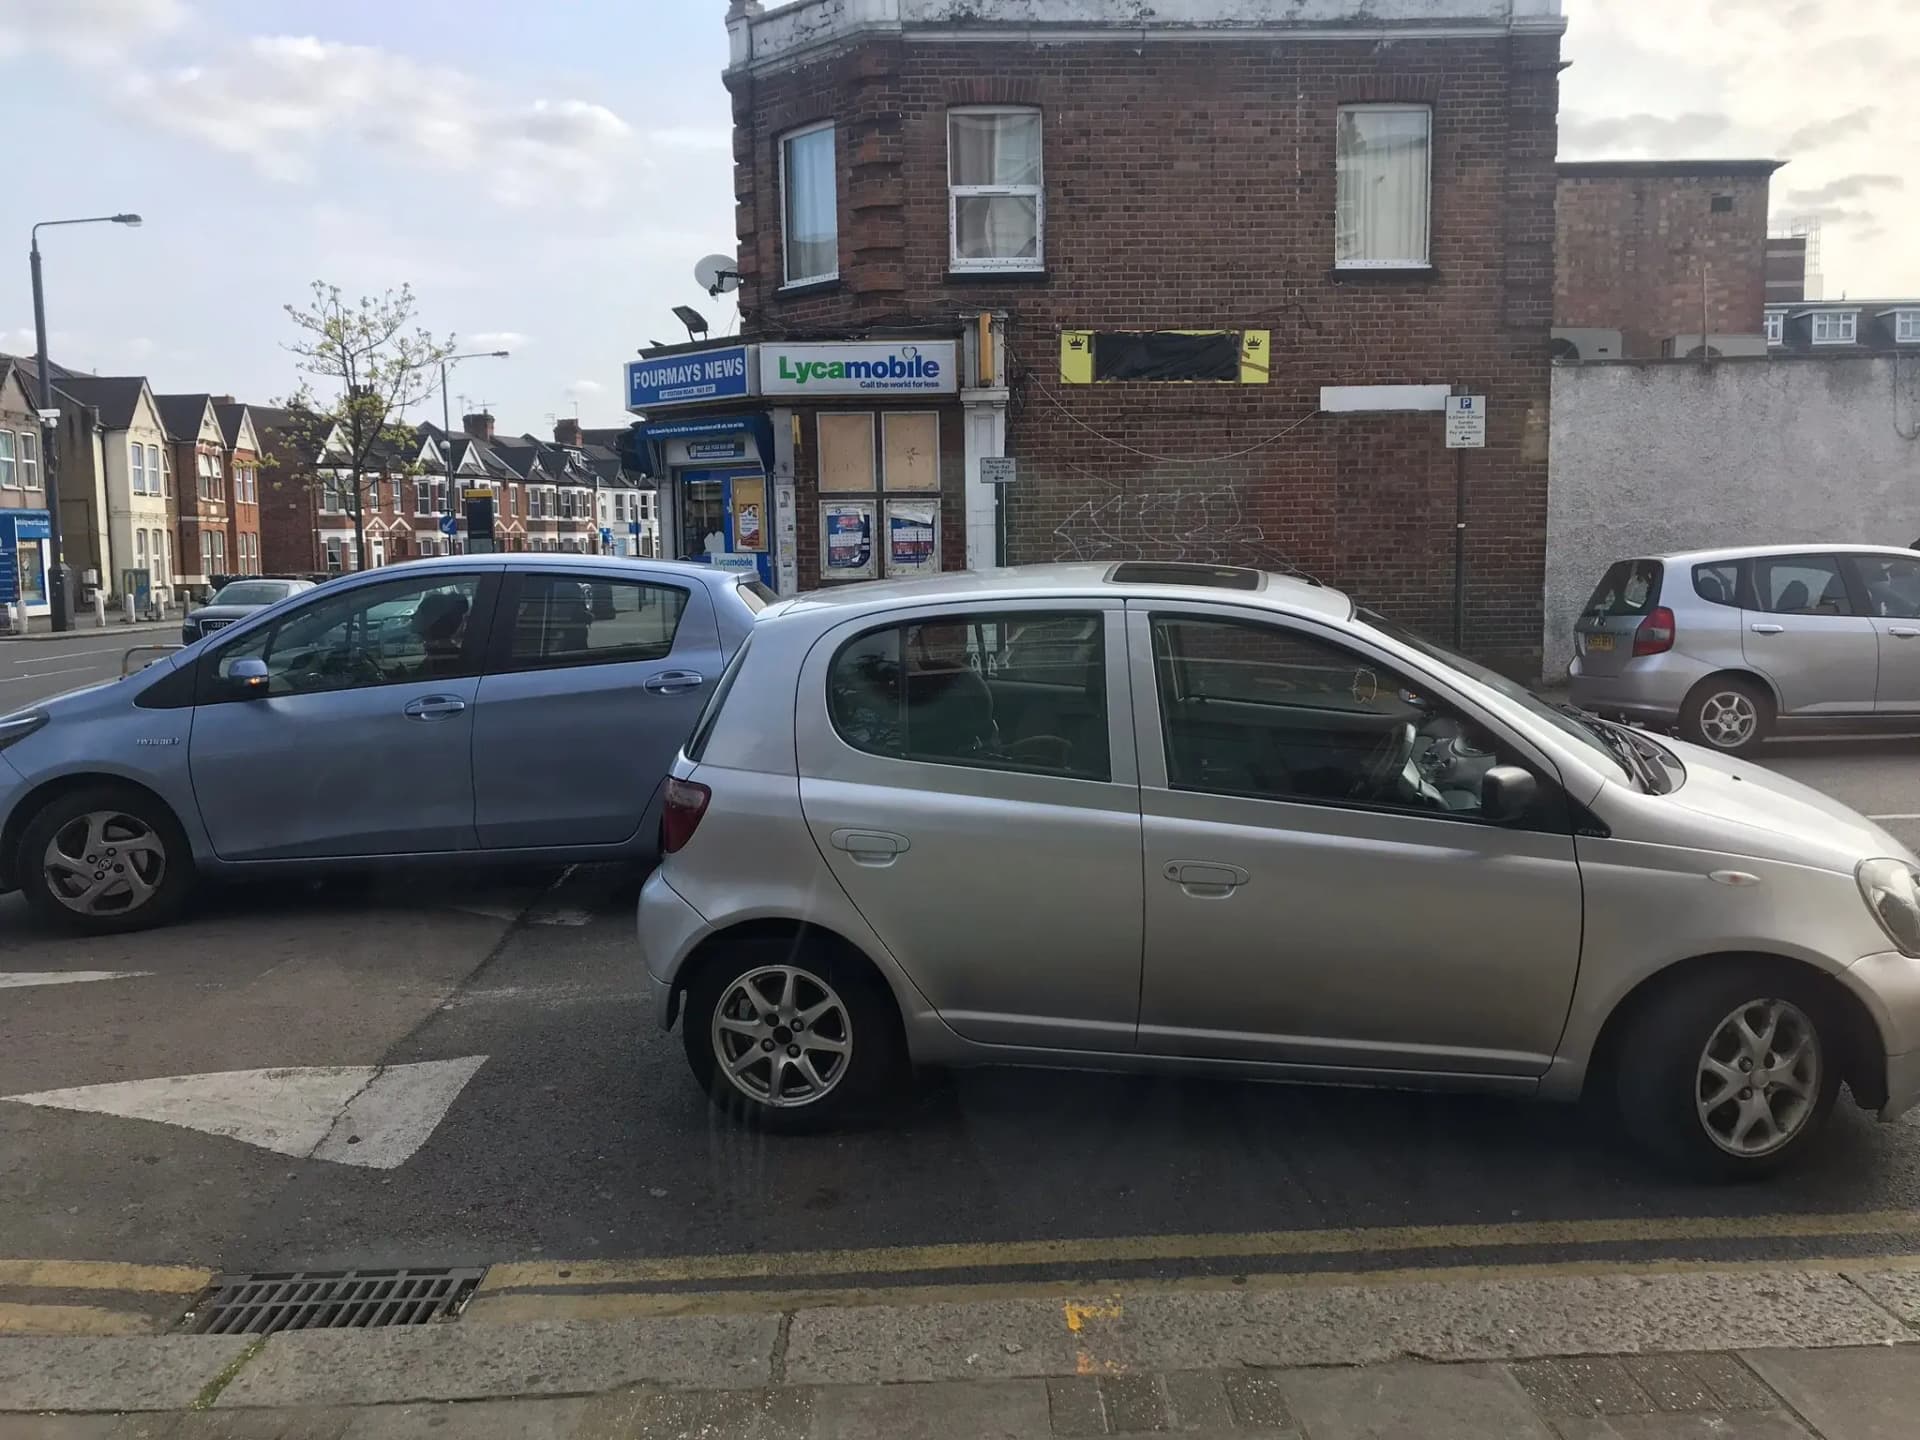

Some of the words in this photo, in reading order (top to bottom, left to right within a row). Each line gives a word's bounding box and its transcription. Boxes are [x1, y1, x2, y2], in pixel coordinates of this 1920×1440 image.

[633, 363, 701, 390] FOURMAYS
[705, 357, 743, 380] NEWS
[778, 355, 940, 384] Lycamobile
[860, 381, 875, 389] Call
[876, 381, 889, 389] the
[890, 381, 912, 389] world
[913, 381, 923, 389] for
[924, 381, 940, 389] less
